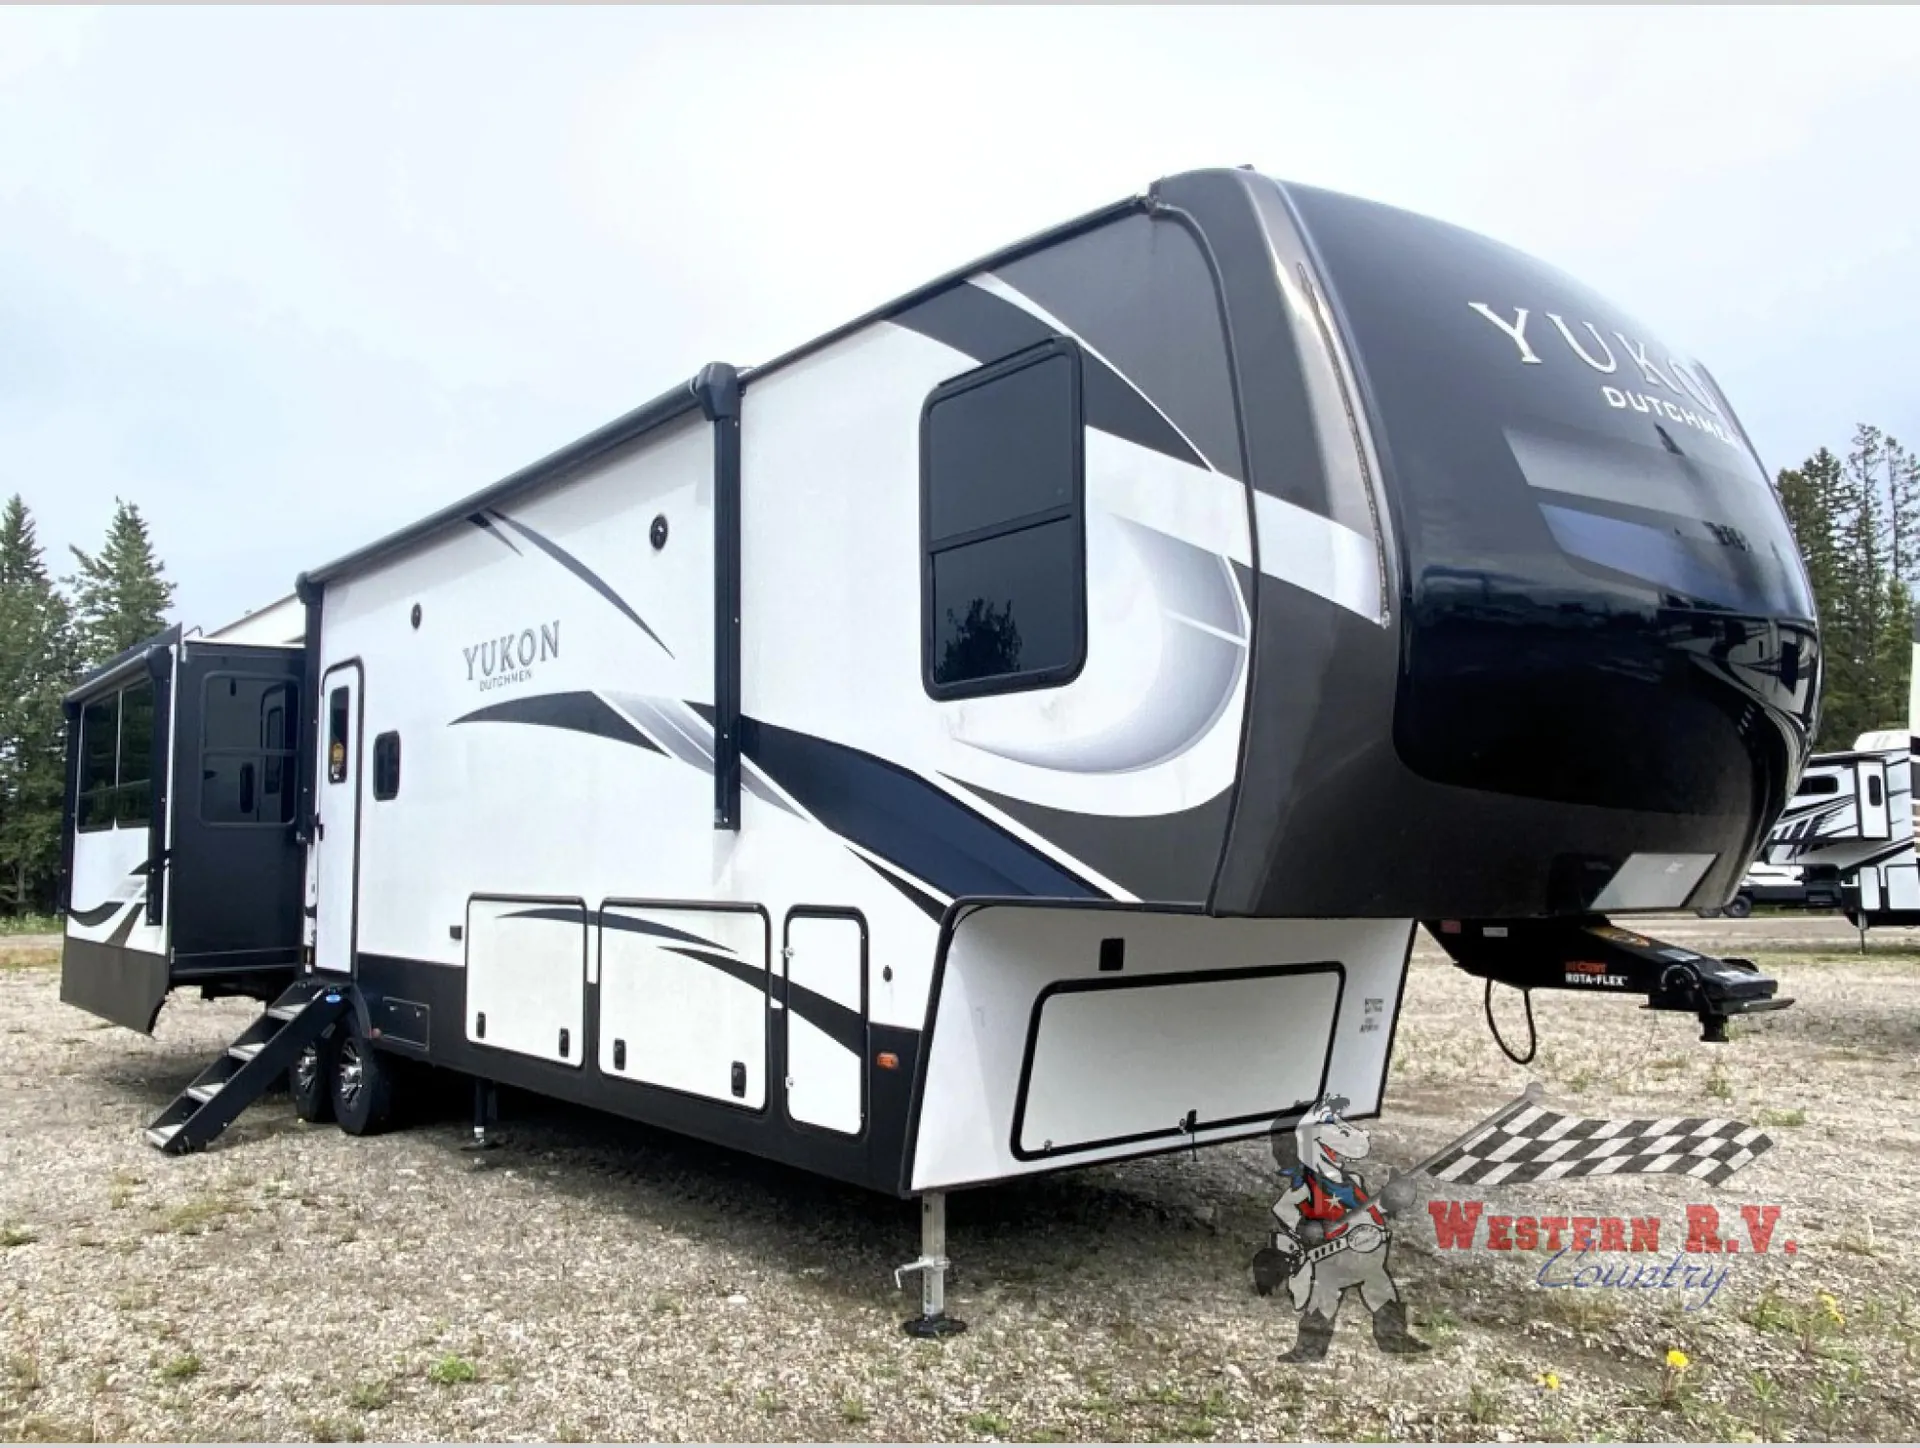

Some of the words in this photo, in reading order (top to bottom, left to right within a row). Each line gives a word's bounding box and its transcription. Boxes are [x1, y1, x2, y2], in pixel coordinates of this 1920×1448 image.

[1467, 301, 1720, 416] YUKO
[462, 619, 560, 681] YUKON
[479, 669, 532, 692] DUTCHMEN
